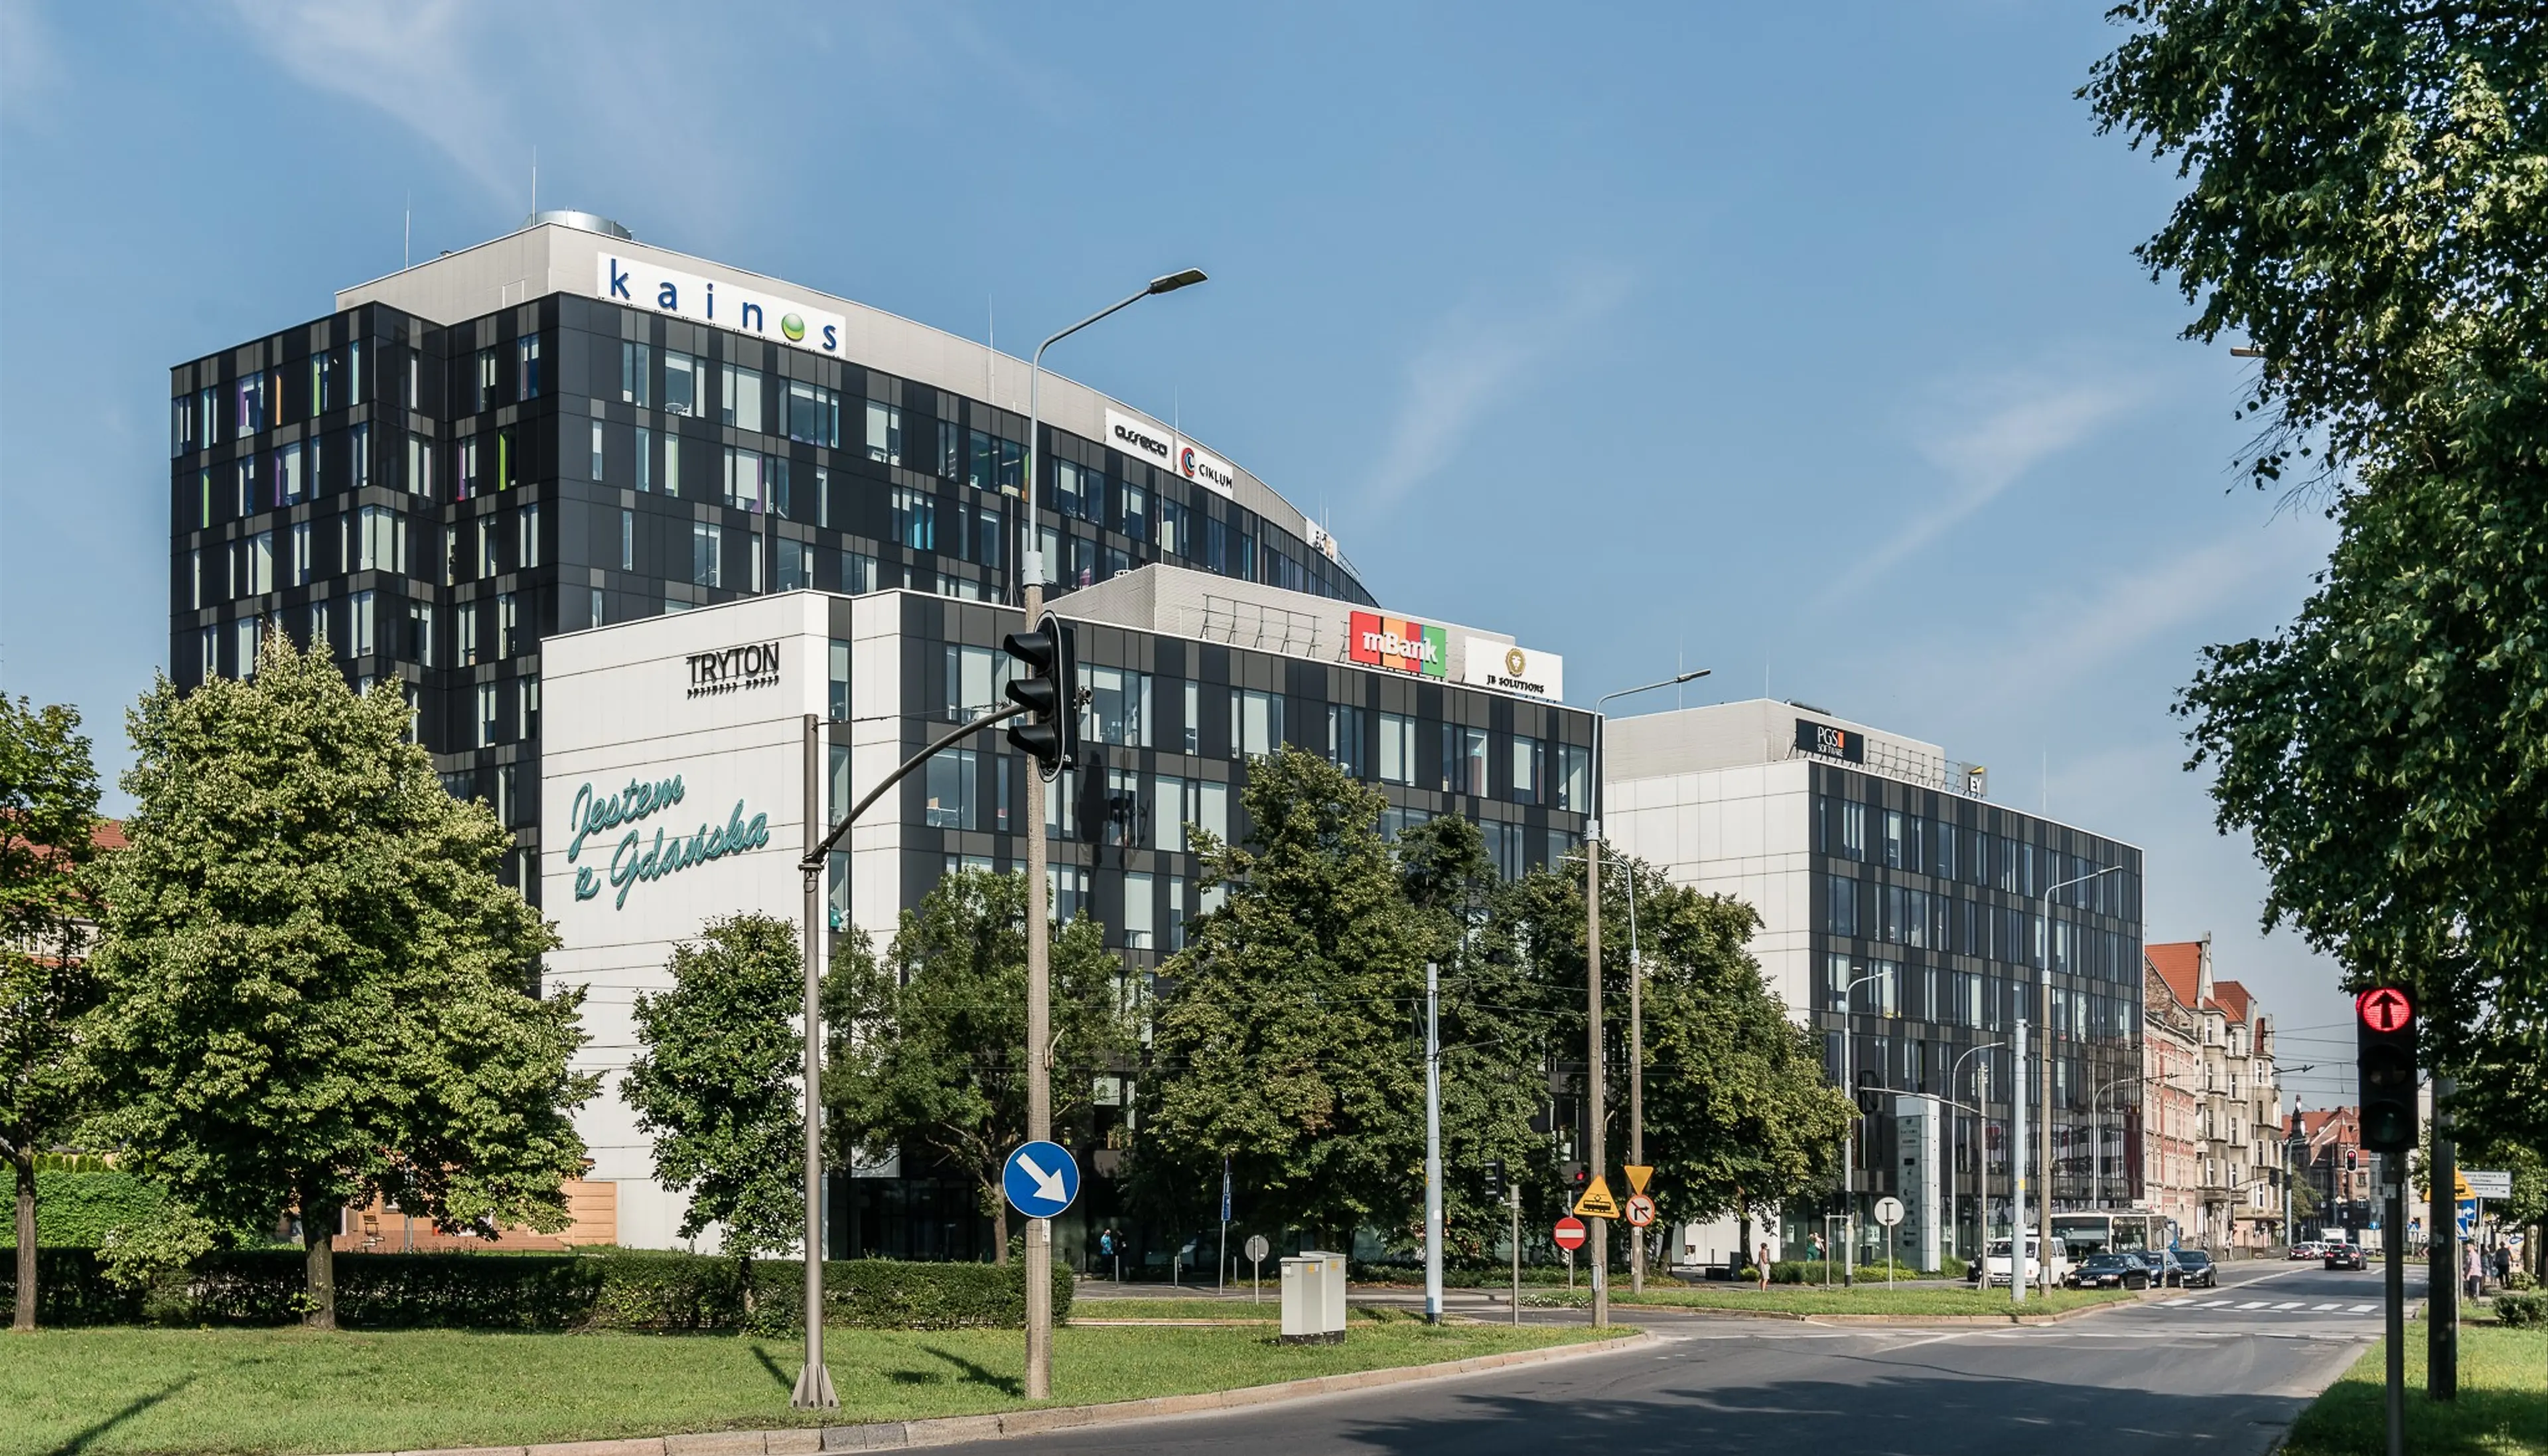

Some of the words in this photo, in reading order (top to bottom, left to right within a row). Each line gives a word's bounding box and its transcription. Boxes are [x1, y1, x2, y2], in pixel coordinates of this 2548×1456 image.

[610, 258, 837, 350] kainos
[1199, 464, 1232, 490] CIKLUM
[686, 641, 780, 687] TRYTON
[1362, 631, 1438, 665] mBank
[1487, 674, 1496, 685] JB
[1499, 677, 1545, 694] SOLUTIONS
[1817, 726, 1838, 747] PGS
[1969, 777, 1982, 793] EY
[568, 774, 685, 863] Jestem
[610, 798, 770, 911] Gdańska
